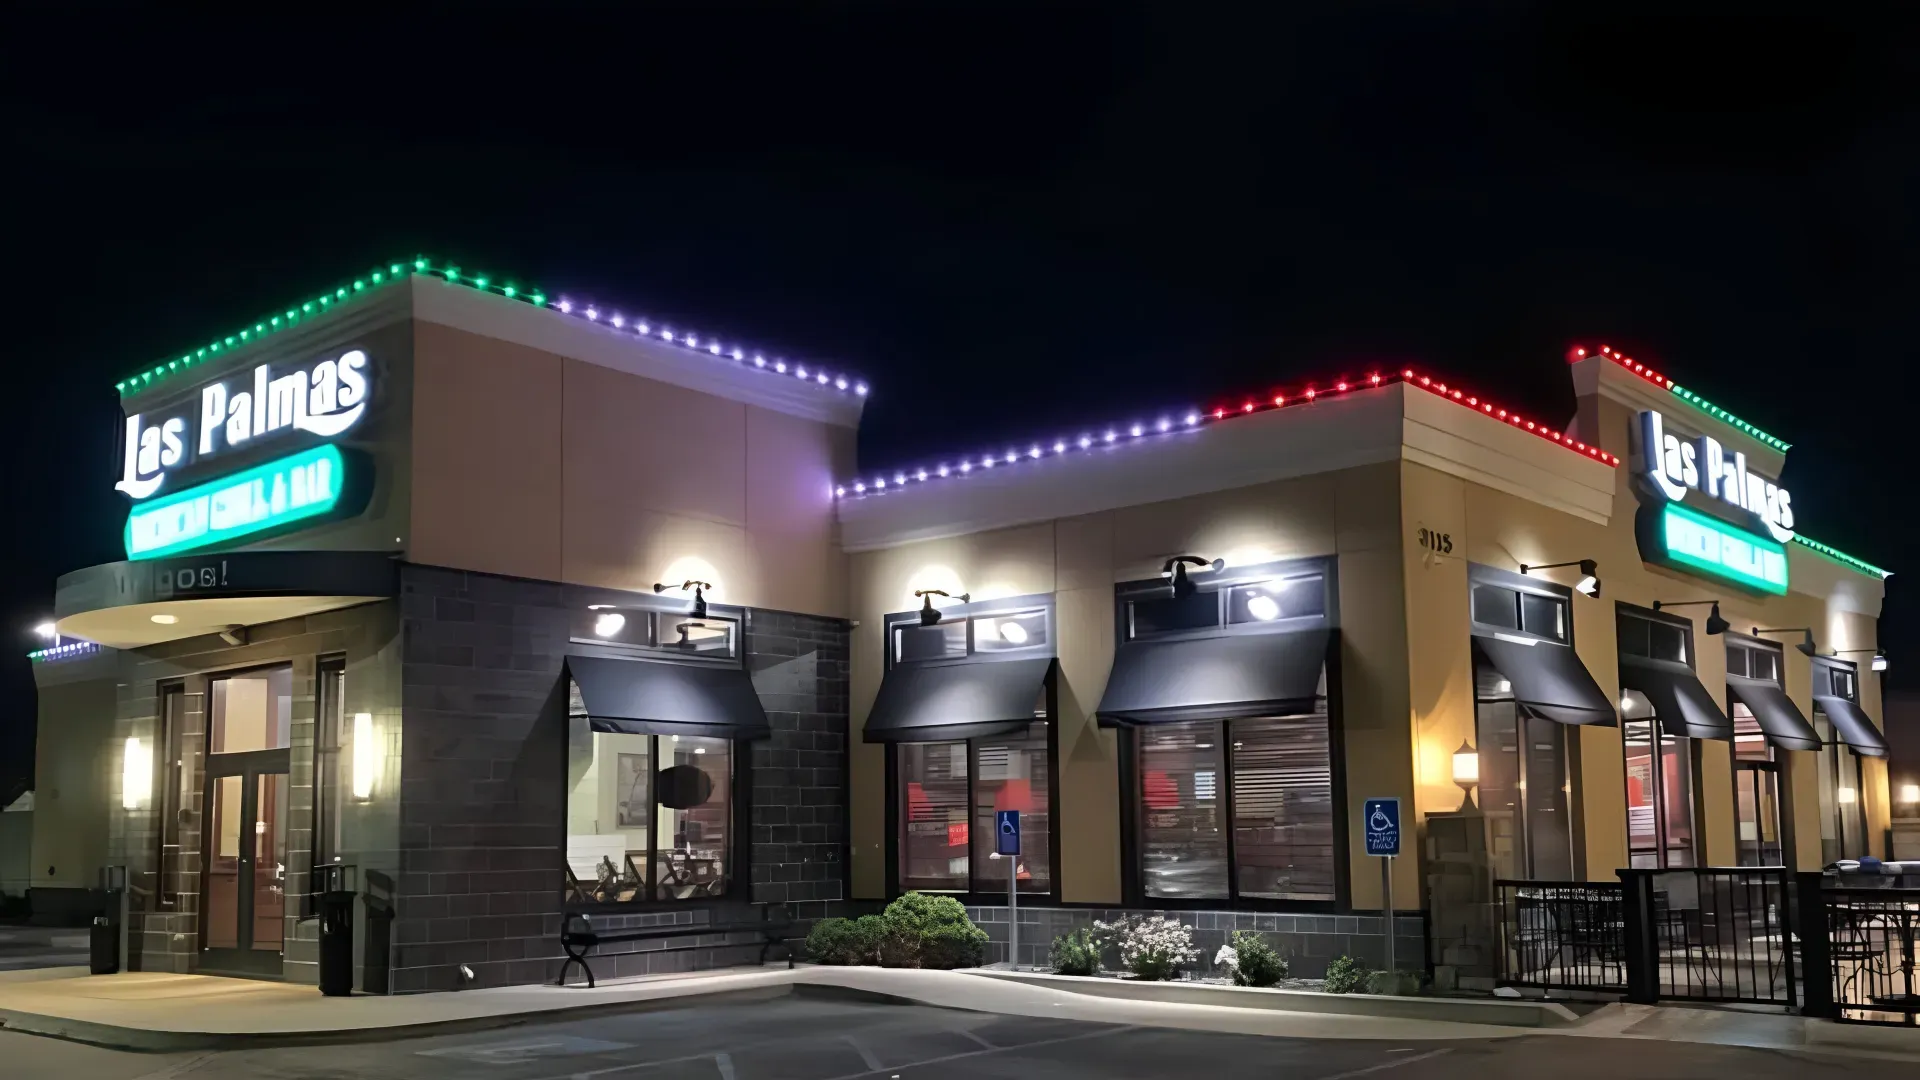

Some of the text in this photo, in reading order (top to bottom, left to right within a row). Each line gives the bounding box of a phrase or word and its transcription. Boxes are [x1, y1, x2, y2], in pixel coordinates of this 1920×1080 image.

[114, 350, 366, 499] Las Palmas
[1650, 410, 1795, 543] Las Palmas
